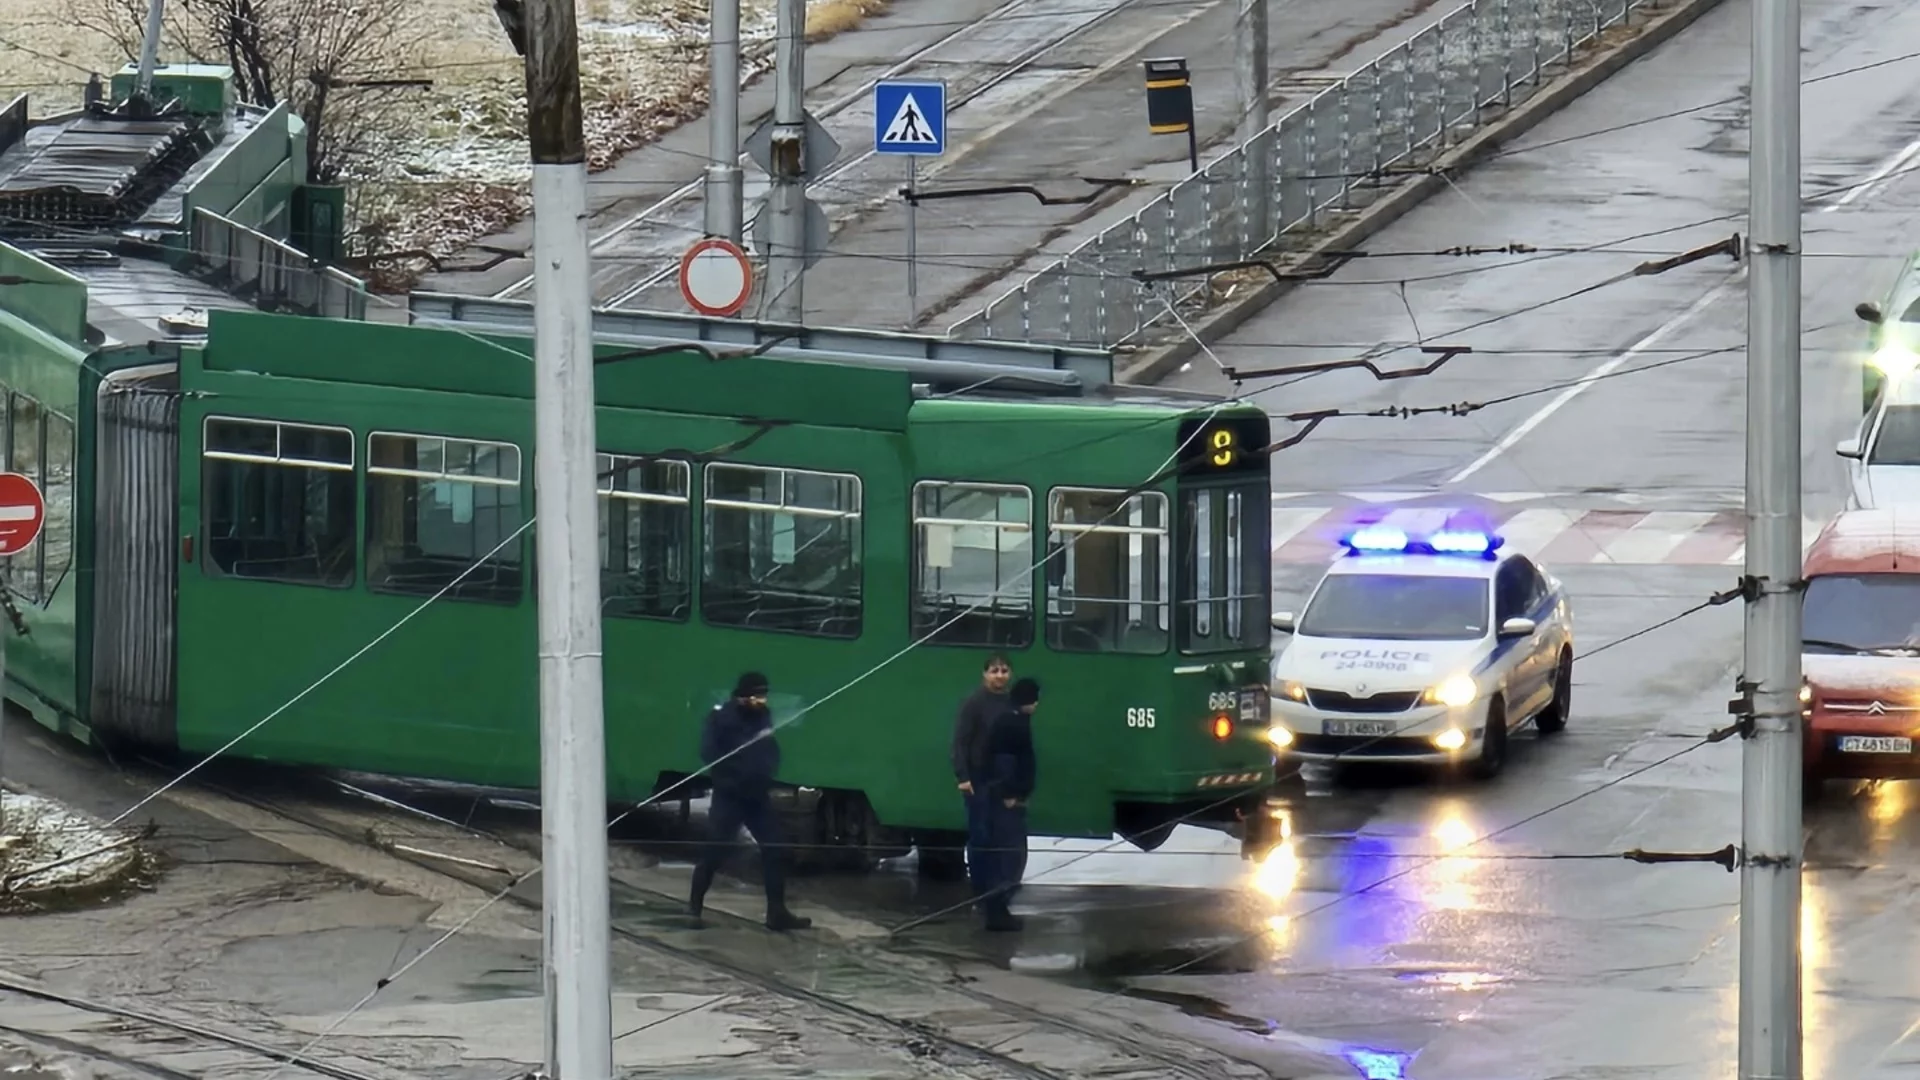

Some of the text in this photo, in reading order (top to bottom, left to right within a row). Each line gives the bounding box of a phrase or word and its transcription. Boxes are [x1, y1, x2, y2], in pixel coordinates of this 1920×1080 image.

[1213, 430, 1231, 466] 9
[1320, 649, 1430, 661] POLICE
[1208, 691, 1236, 710] 685
[1127, 707, 1156, 728] 685
